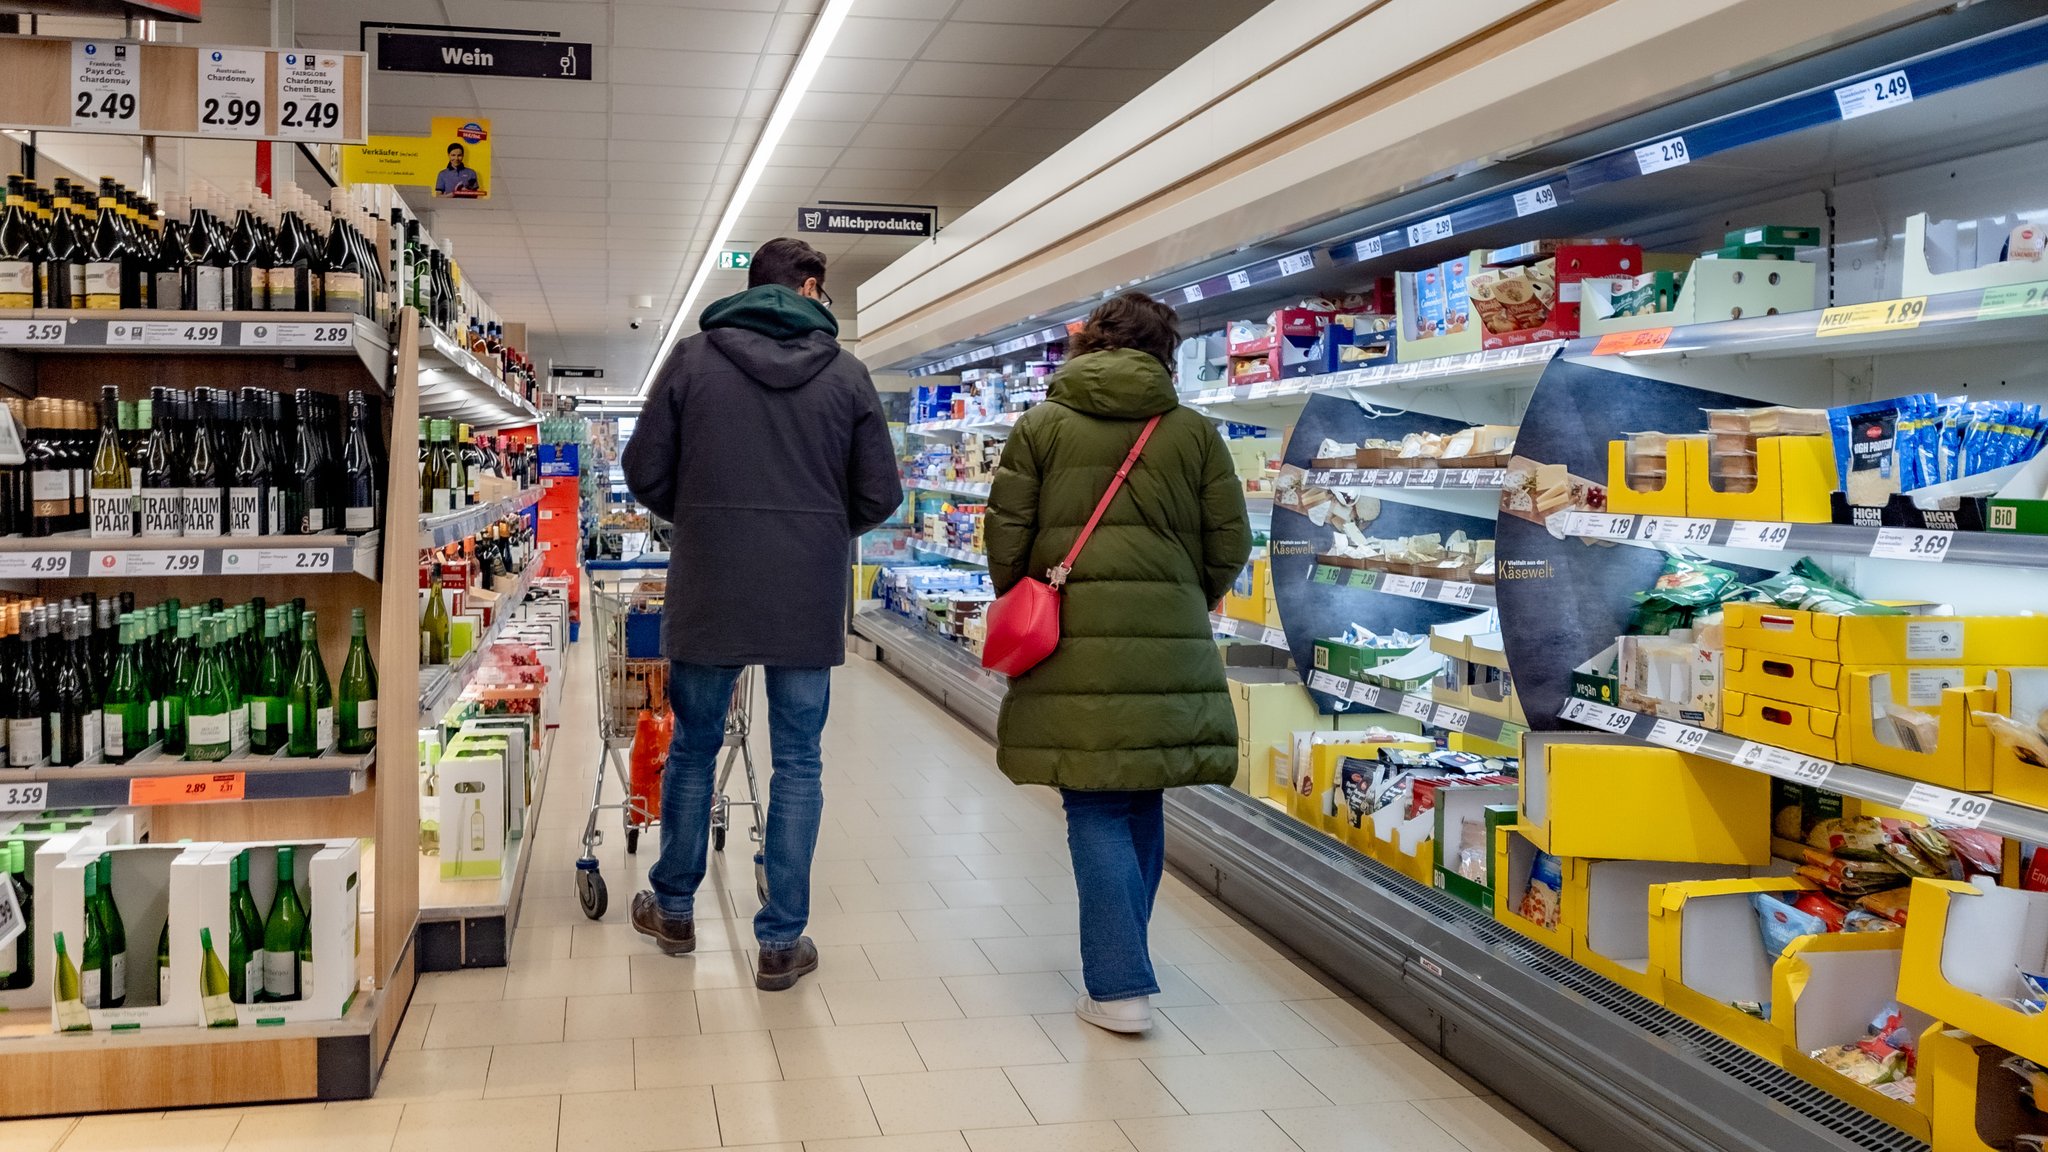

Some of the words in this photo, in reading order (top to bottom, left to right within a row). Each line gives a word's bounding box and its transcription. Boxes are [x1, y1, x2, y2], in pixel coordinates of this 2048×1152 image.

[441, 47, 494, 66] Wein
[86, 68, 104, 76] Pays
[207, 74, 256, 84] Chardonnay
[80, 76, 131, 86] Chardonnay
[286, 77, 333, 86] Chardonnay
[1874, 76, 1906, 100] 2.49
[76, 92, 136, 120] 2.49
[202, 98, 261, 126] 2.99
[281, 101, 339, 128] 2.49
[362, 148, 398, 156] Verkäufer
[1662, 141, 1684, 161] 2.19
[1536, 189, 1552, 205] 4.99
[829, 216, 924, 231] Milchprodukte
[1436, 220, 1450, 234] 2.99
[1822, 312, 1852, 326] NEU!
[1885, 300, 1922, 324] 1.89
[26, 324, 62, 340] 3.59
[184, 327, 218, 340] 4.99
[314, 328, 348, 342] 2.89
[1870, 438, 1892, 452] PROTEIN
[1490, 470, 1506, 484] 2.5
[1854, 508, 1881, 520] HIGH
[1922, 511, 1956, 523] HIGH
[1995, 509, 2012, 526] BiO
[96, 516, 129, 531] PAAR
[146, 514, 179, 530] PAAR
[1610, 518, 1630, 534] 1.19
[1854, 519, 1882, 527] PROTEIN
[1926, 520, 1958, 530] PROTEIN
[1684, 524, 1711, 540] 5.19
[1758, 528, 1787, 543] 4.49
[1273, 540, 1315, 554] Käsewelt
[1910, 535, 1948, 554] 3.69
[32, 557, 66, 571] 4.99
[165, 554, 200, 570] 7.99
[296, 552, 329, 568] 2.79
[1498, 560, 1555, 579] Käsewelt
[1410, 580, 1424, 594] 1.07
[1455, 587, 1472, 600] 2.19
[1316, 650, 1326, 666] BiO
[1365, 687, 1378, 702] 4.11
[1577, 682, 1597, 698] vegan
[1415, 704, 1430, 716] 2.49
[1450, 714, 1467, 728] 2.49
[1606, 713, 1631, 728] 1.99
[1676, 729, 1703, 747] 1.99
[1794, 760, 1827, 780] 1.99
[186, 783, 206, 793] 2.89
[7, 788, 42, 804] 3.59
[1946, 797, 1987, 820] 1.99
[1434, 870, 1446, 890] BiO
